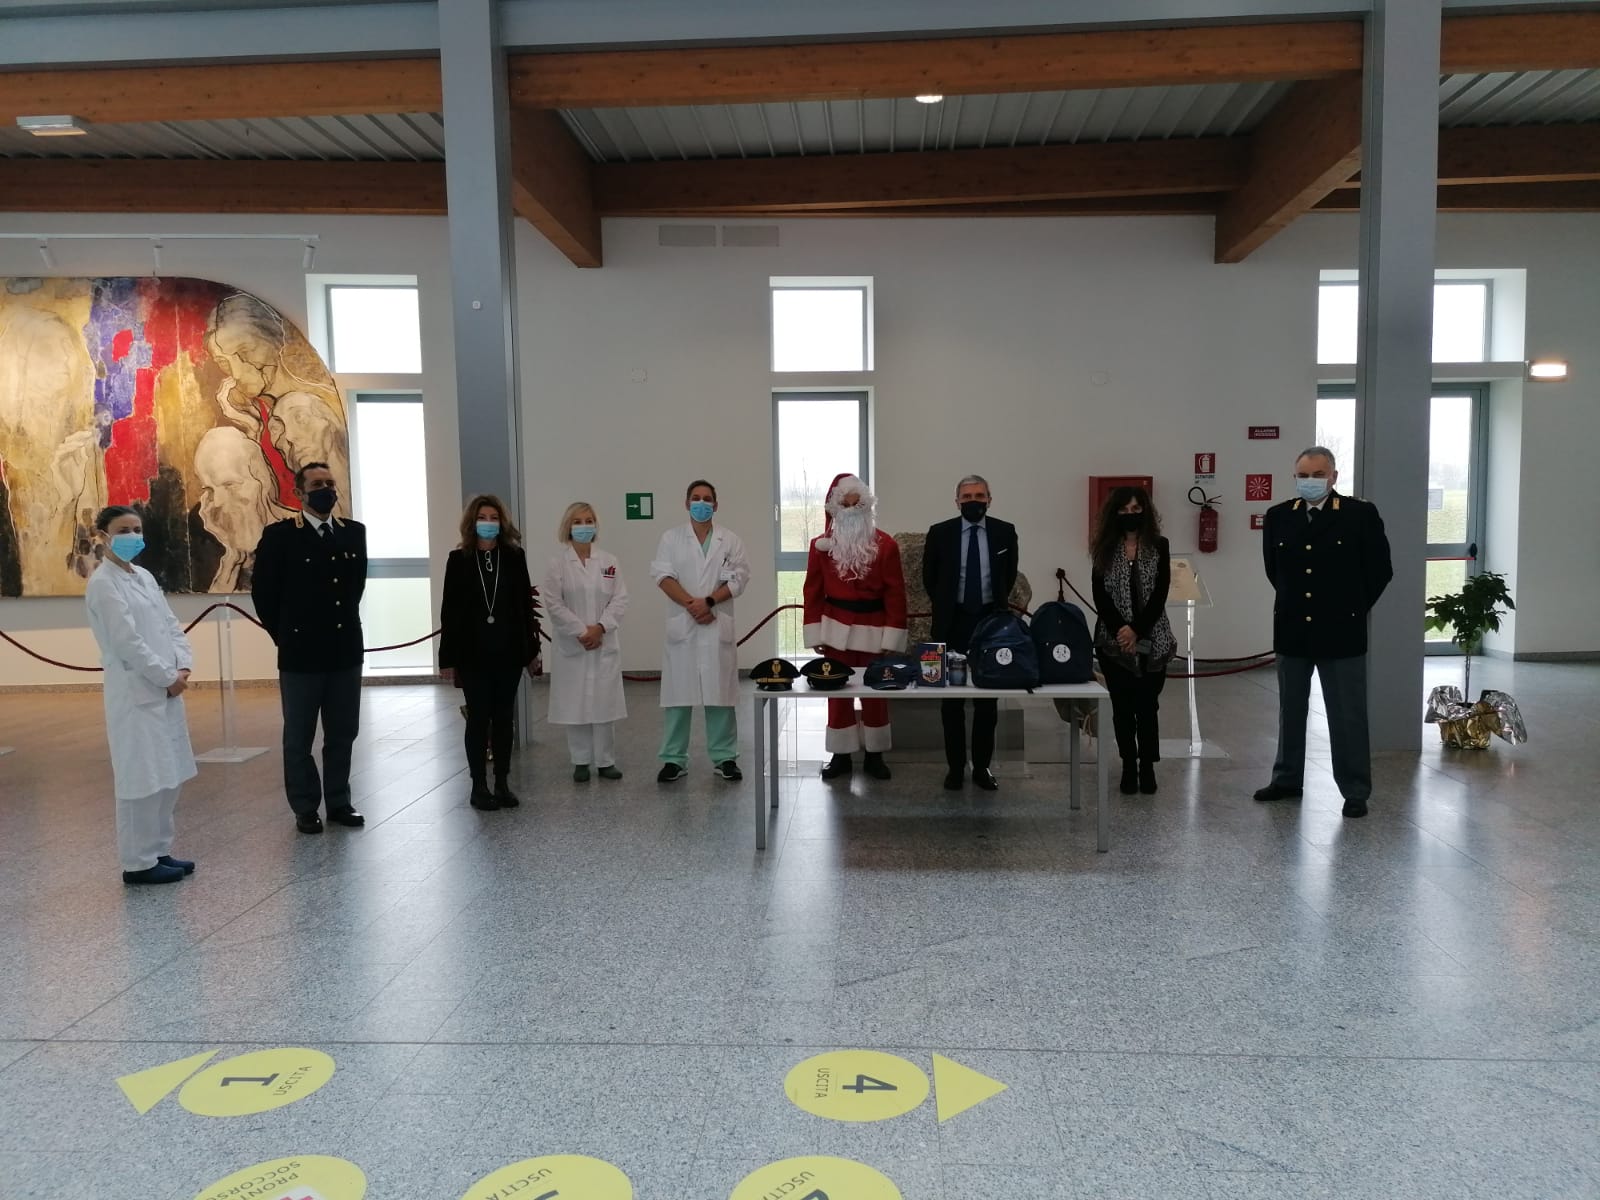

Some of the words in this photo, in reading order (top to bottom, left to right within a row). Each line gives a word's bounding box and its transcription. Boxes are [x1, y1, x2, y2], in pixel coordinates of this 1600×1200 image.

[220, 1072, 280, 1087] 1
[273, 1065, 312, 1096] USCITA
[815, 1067, 830, 1099] USCITA
[842, 1074, 898, 1094] 4
[237, 1172, 300, 1200] PRONT
[762, 1170, 816, 1200] USCIT
